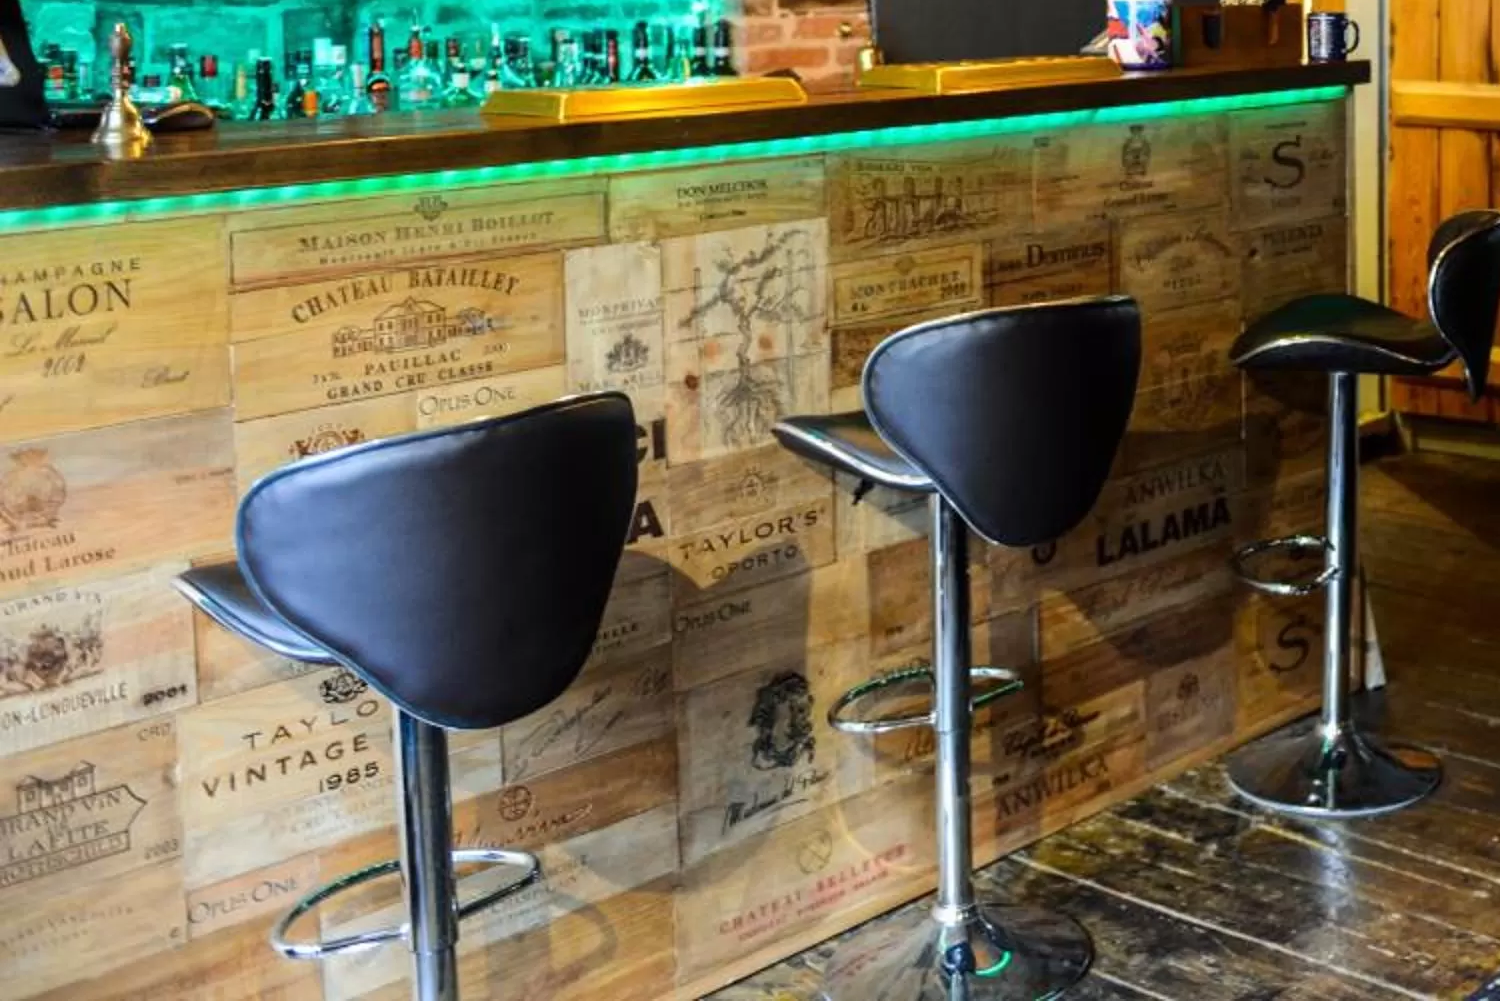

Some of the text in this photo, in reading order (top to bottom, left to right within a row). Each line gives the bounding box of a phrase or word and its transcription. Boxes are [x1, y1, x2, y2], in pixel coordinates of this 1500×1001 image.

[676, 185, 706, 200] DON
[297, 230, 387, 253] MAISON
[0, 278, 132, 325] ALON
[291, 274, 395, 324] CHATEAU
[364, 348, 462, 377] PAUILLAC
[326, 378, 384, 401] GRAND
[394, 370, 427, 390] CRU
[1095, 496, 1232, 568] LALAMA
[43, 547, 117, 573] Larose
[710, 544, 801, 582] OPORTO
[241, 699, 380, 750] TAYLO
[202, 733, 370, 799] VINTAGE
[319, 760, 381, 793] 1985
